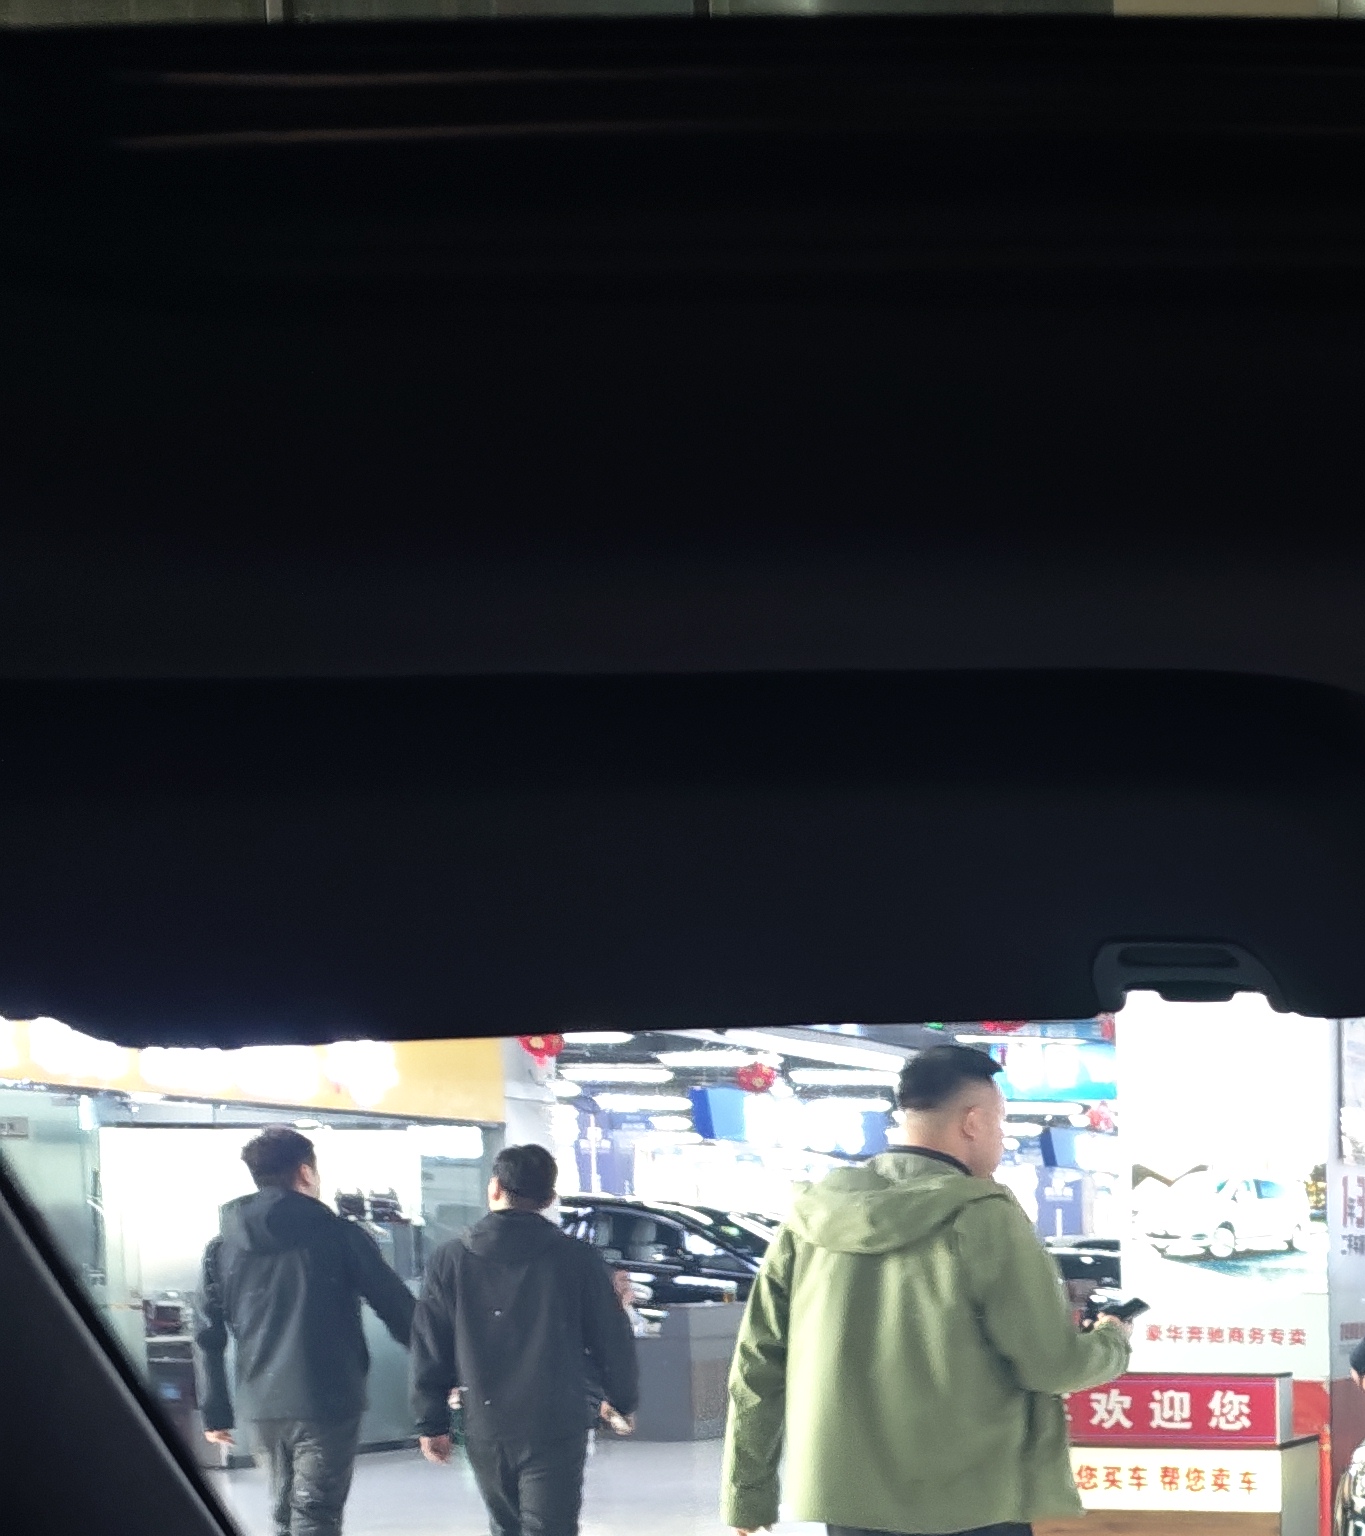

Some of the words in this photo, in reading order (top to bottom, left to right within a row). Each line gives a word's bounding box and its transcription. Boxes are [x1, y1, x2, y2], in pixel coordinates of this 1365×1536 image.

[1145, 1324, 1307, 1346] 豪华奔驰商务专卖
[1061, 1388, 1252, 1432] 欢迎您
[1160, 1464, 1259, 1495] 帮您卖车
